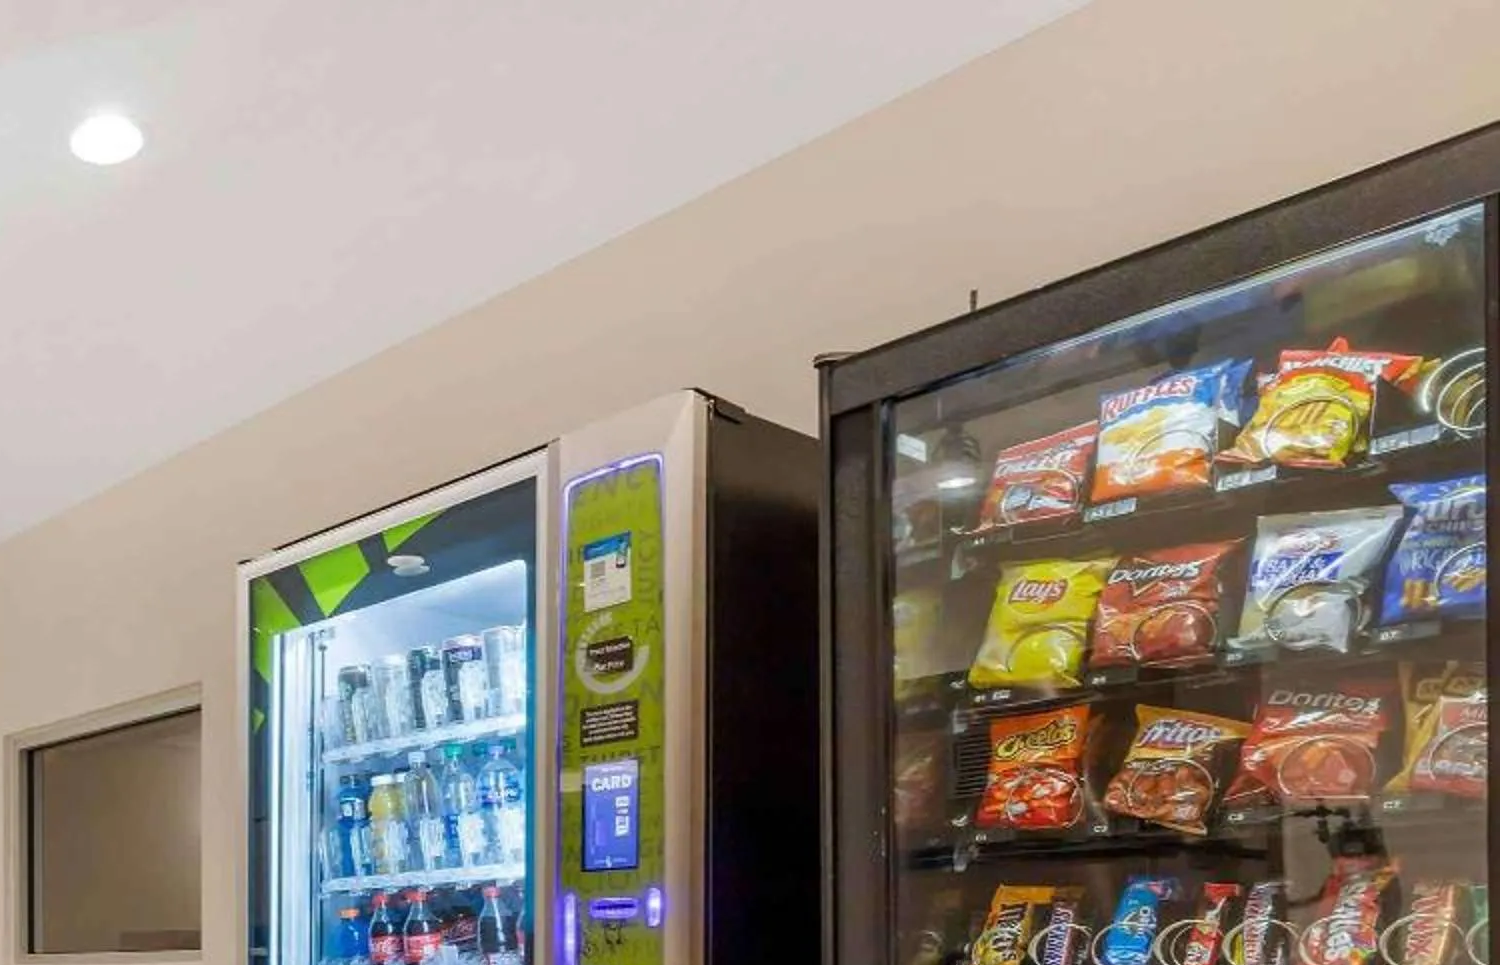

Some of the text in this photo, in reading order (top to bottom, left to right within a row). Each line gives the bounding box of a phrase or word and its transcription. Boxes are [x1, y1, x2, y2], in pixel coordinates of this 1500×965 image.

[1010, 577, 1068, 605] Lay's
[1267, 689, 1381, 714] Doritos
[996, 719, 1077, 758] Cheetos
[590, 774, 632, 792] CARD
